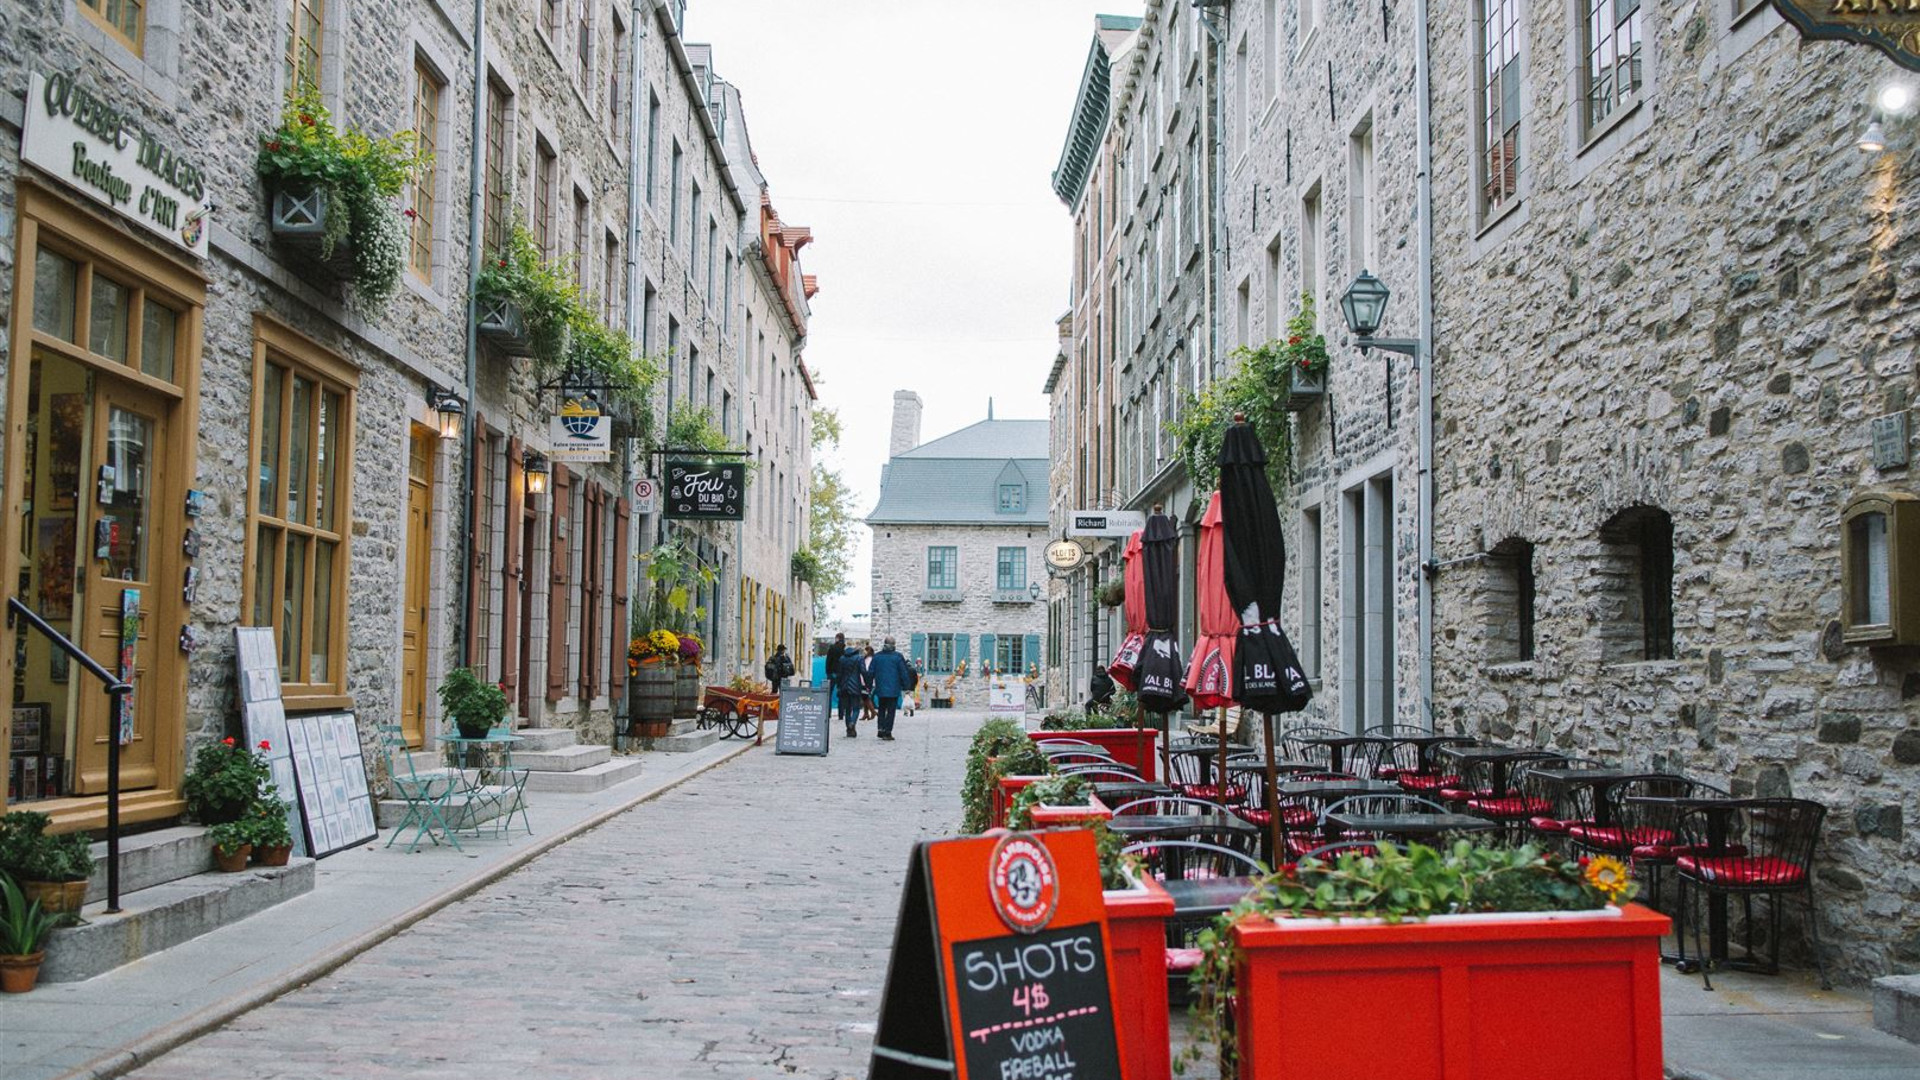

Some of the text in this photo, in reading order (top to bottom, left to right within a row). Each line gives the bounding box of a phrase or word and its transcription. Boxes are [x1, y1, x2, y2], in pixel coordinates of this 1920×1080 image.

[72, 141, 132, 206] Boutique
[136, 127, 206, 201] IMAGES
[684, 470, 724, 498] Fou
[698, 493, 724, 504] DU BIO
[1077, 519, 1105, 527] Richard
[965, 936, 1096, 991] SHOTS
[1012, 982, 1050, 1016] 4$
[1011, 1026, 1065, 1053] VODKA
